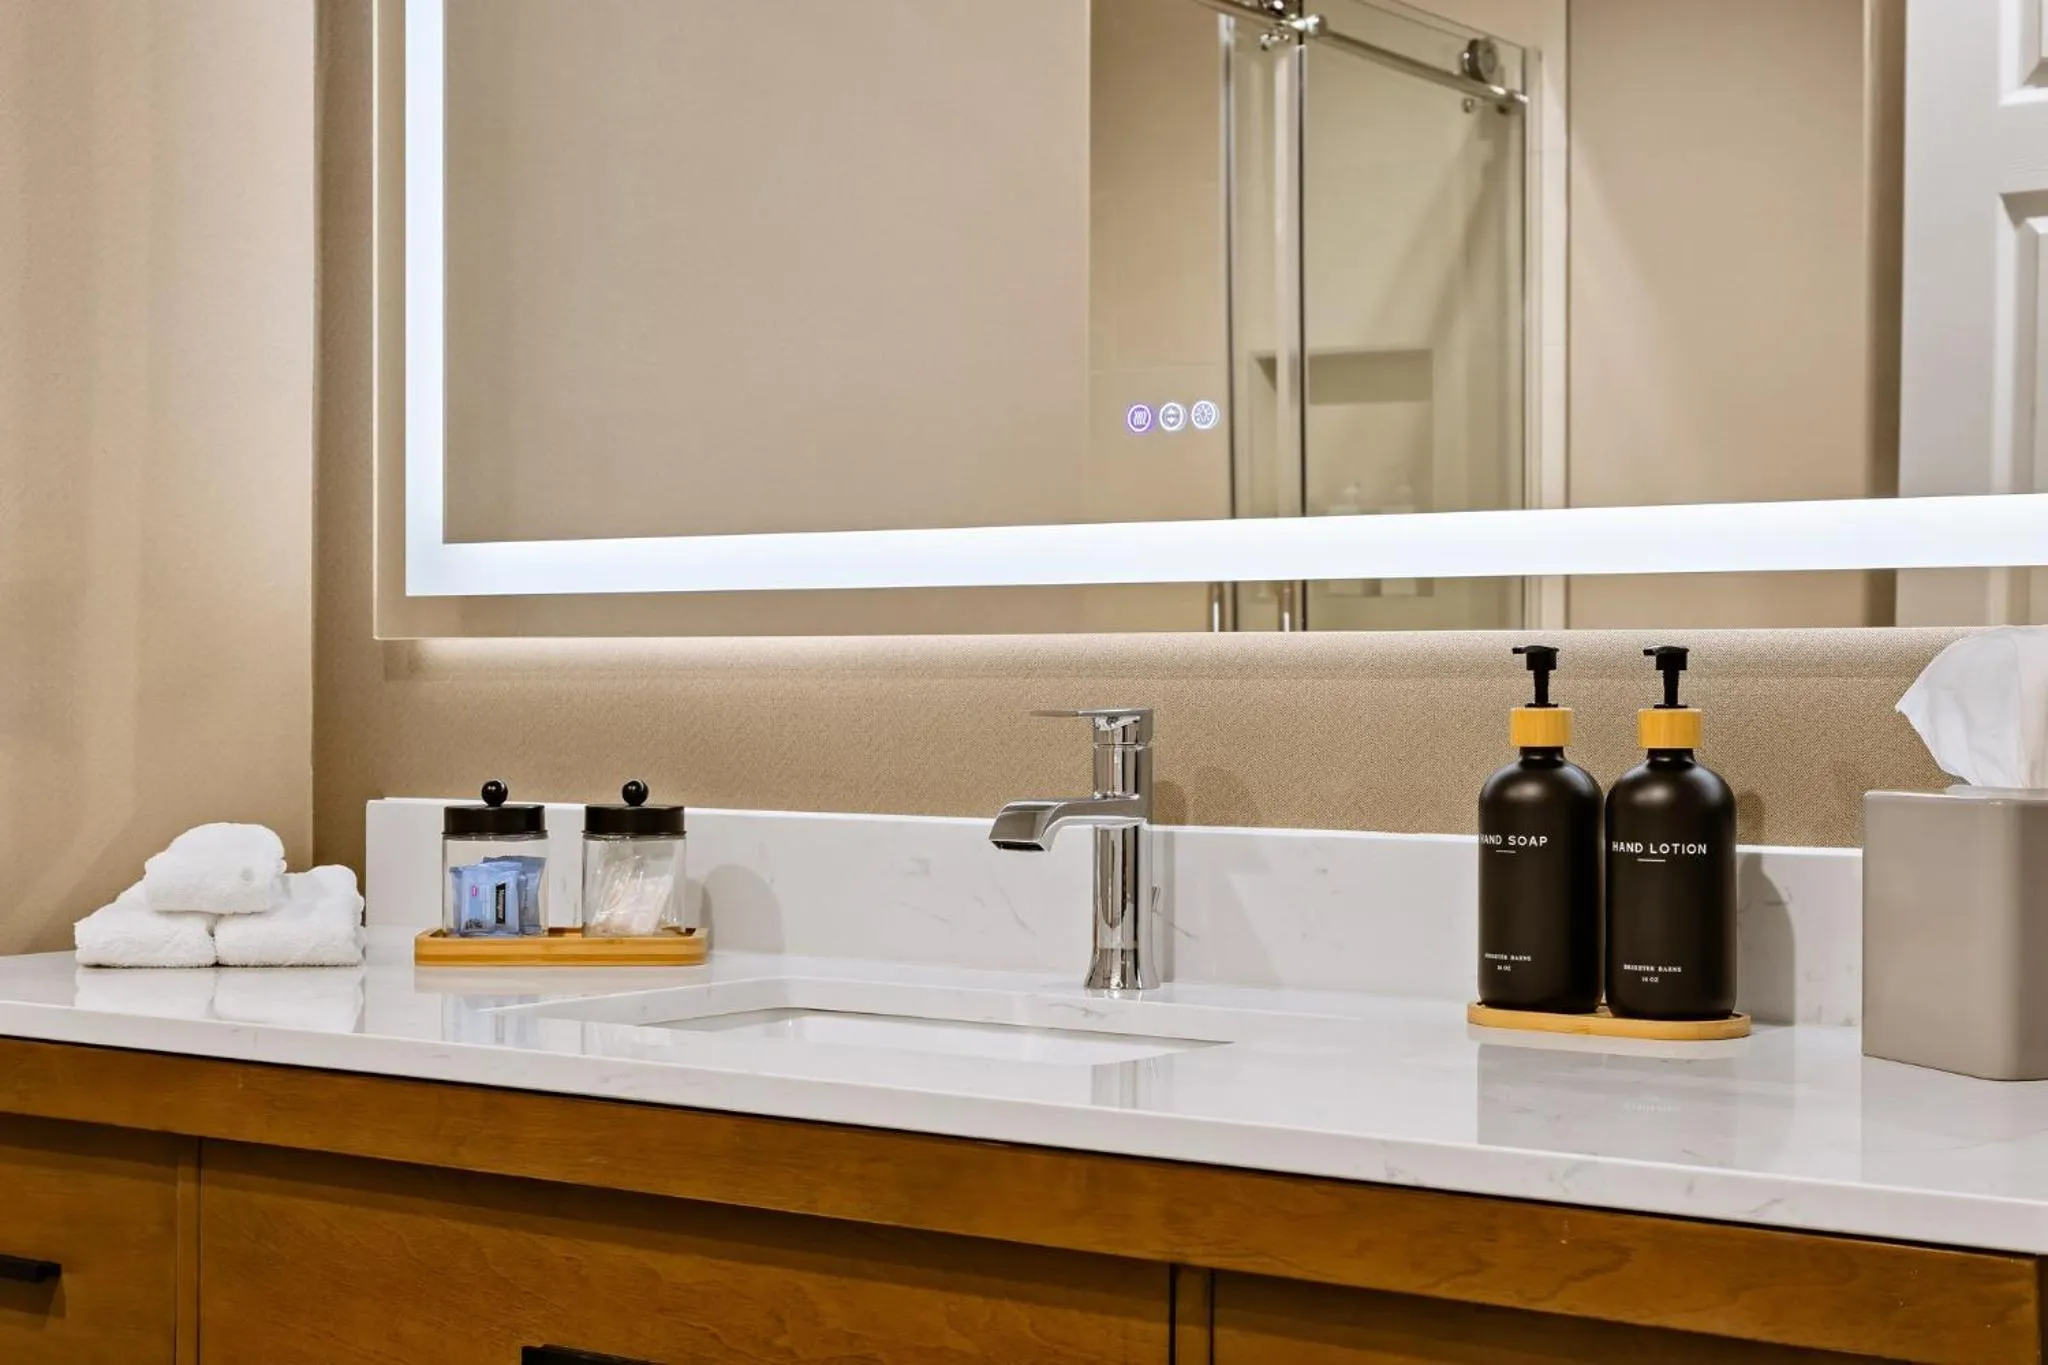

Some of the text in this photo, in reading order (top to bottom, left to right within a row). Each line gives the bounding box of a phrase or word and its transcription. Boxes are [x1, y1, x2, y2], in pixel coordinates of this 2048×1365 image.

[1507, 834, 1548, 847] SOAP
[1611, 840, 1708, 855] HAND LOTION
